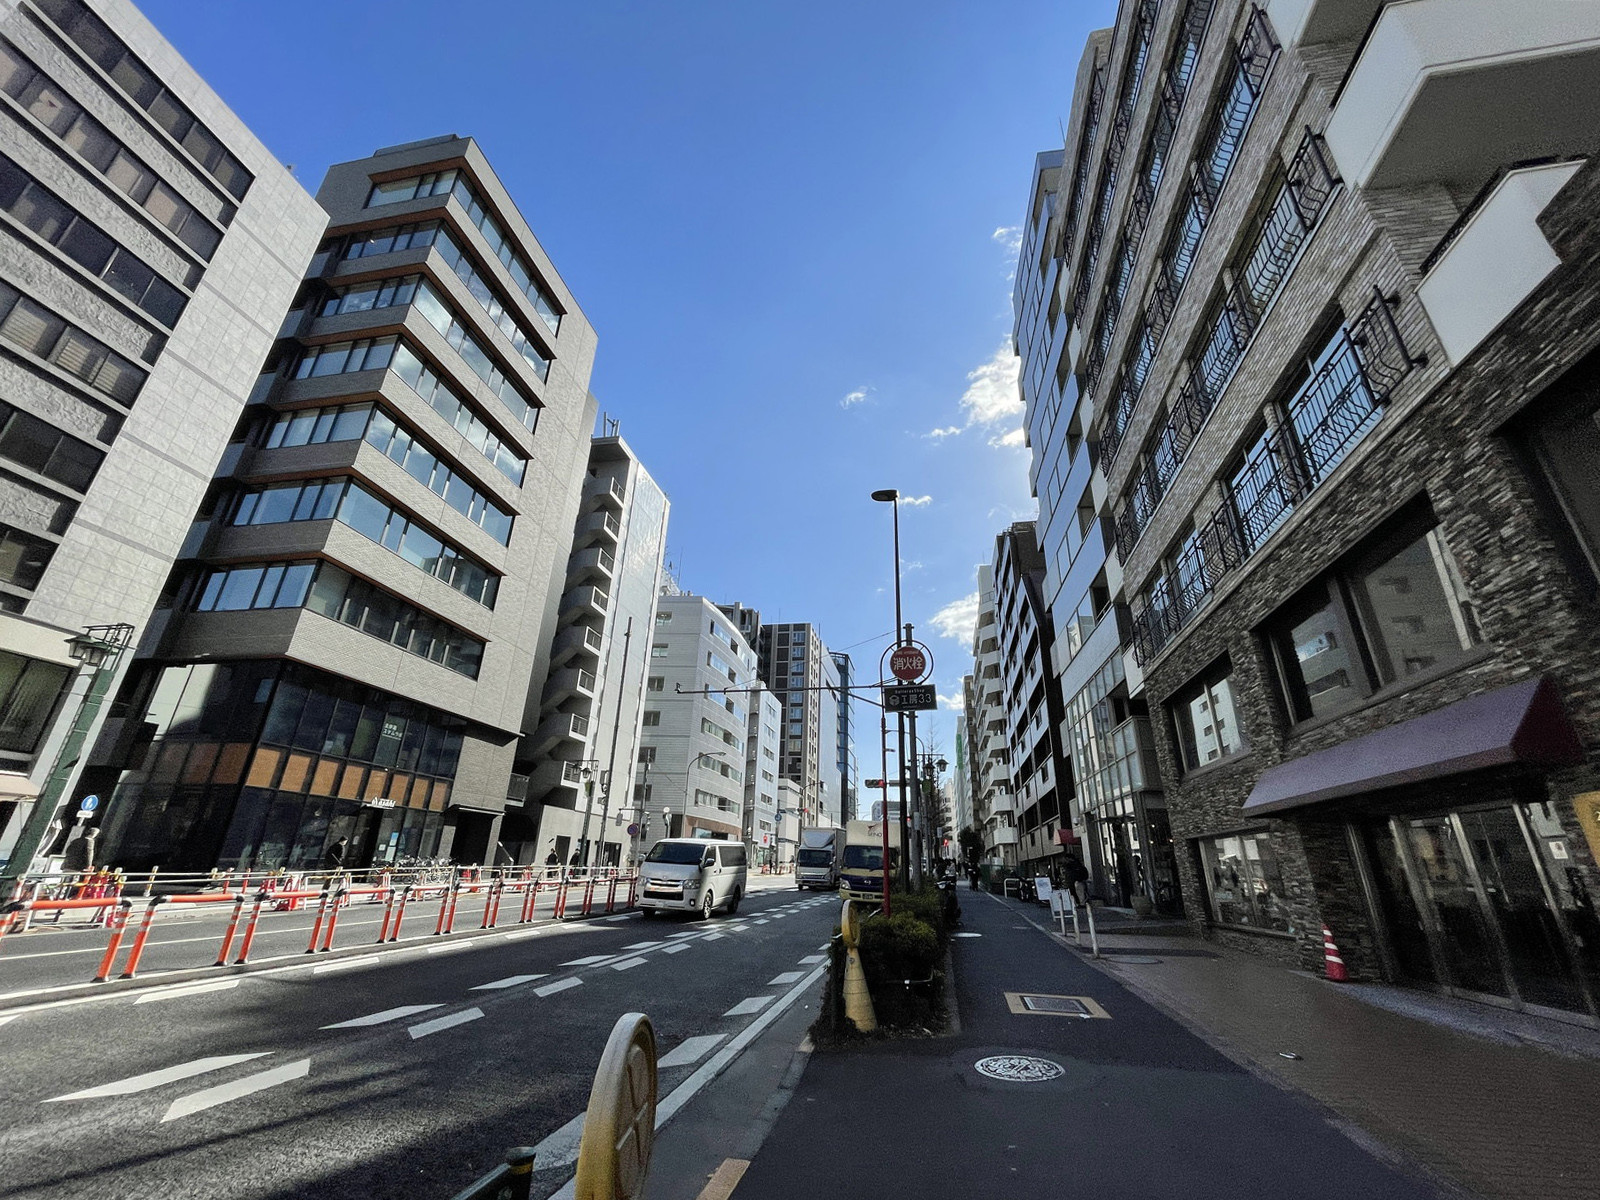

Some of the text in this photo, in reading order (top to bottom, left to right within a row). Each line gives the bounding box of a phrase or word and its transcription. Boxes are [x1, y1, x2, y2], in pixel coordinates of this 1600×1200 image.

[893, 656, 923, 670] 消火栓
[901, 693, 932, 704] 工房33
